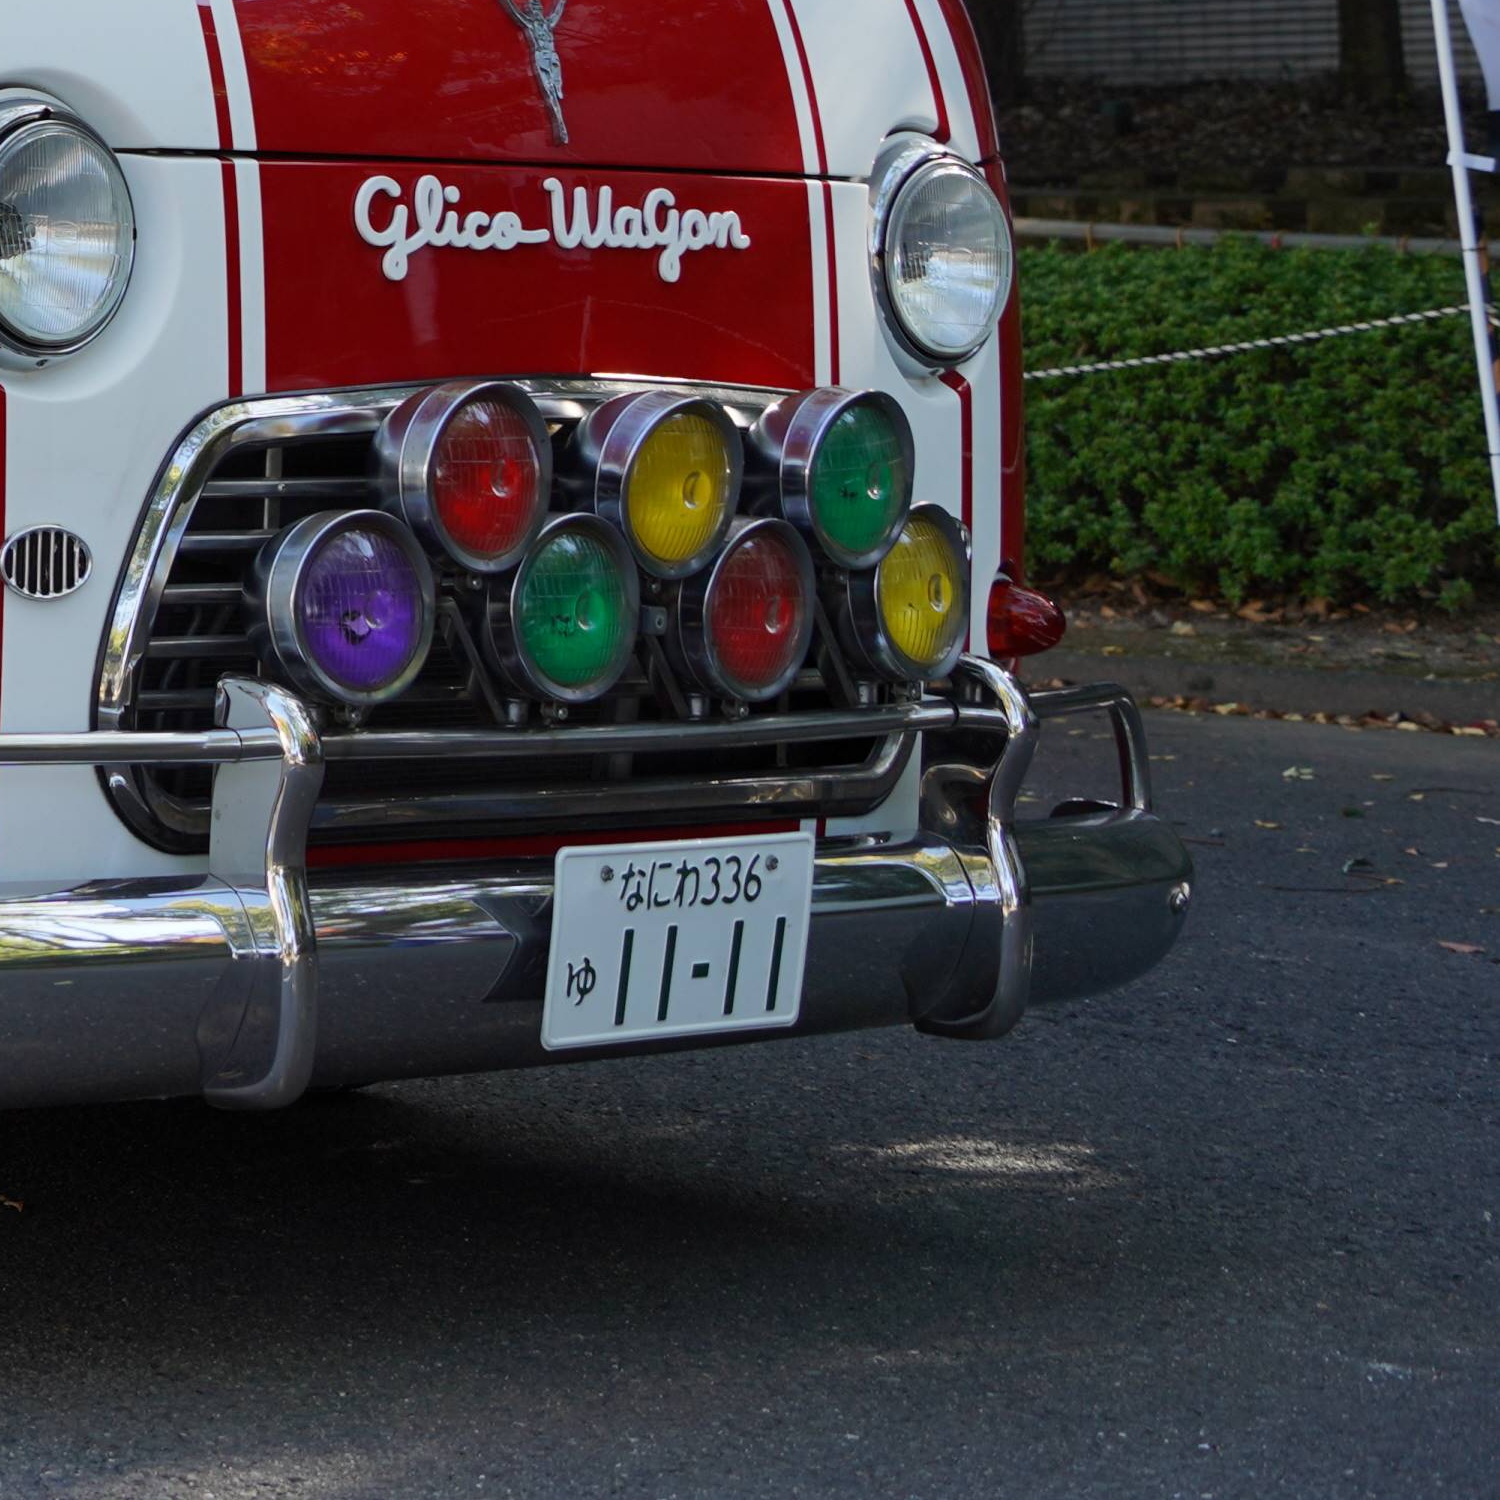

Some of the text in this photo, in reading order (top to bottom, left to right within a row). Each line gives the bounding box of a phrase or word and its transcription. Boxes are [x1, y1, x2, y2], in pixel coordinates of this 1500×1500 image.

[354, 174, 550, 281] Glico
[566, 916, 787, 1027] ゆ 11-11
